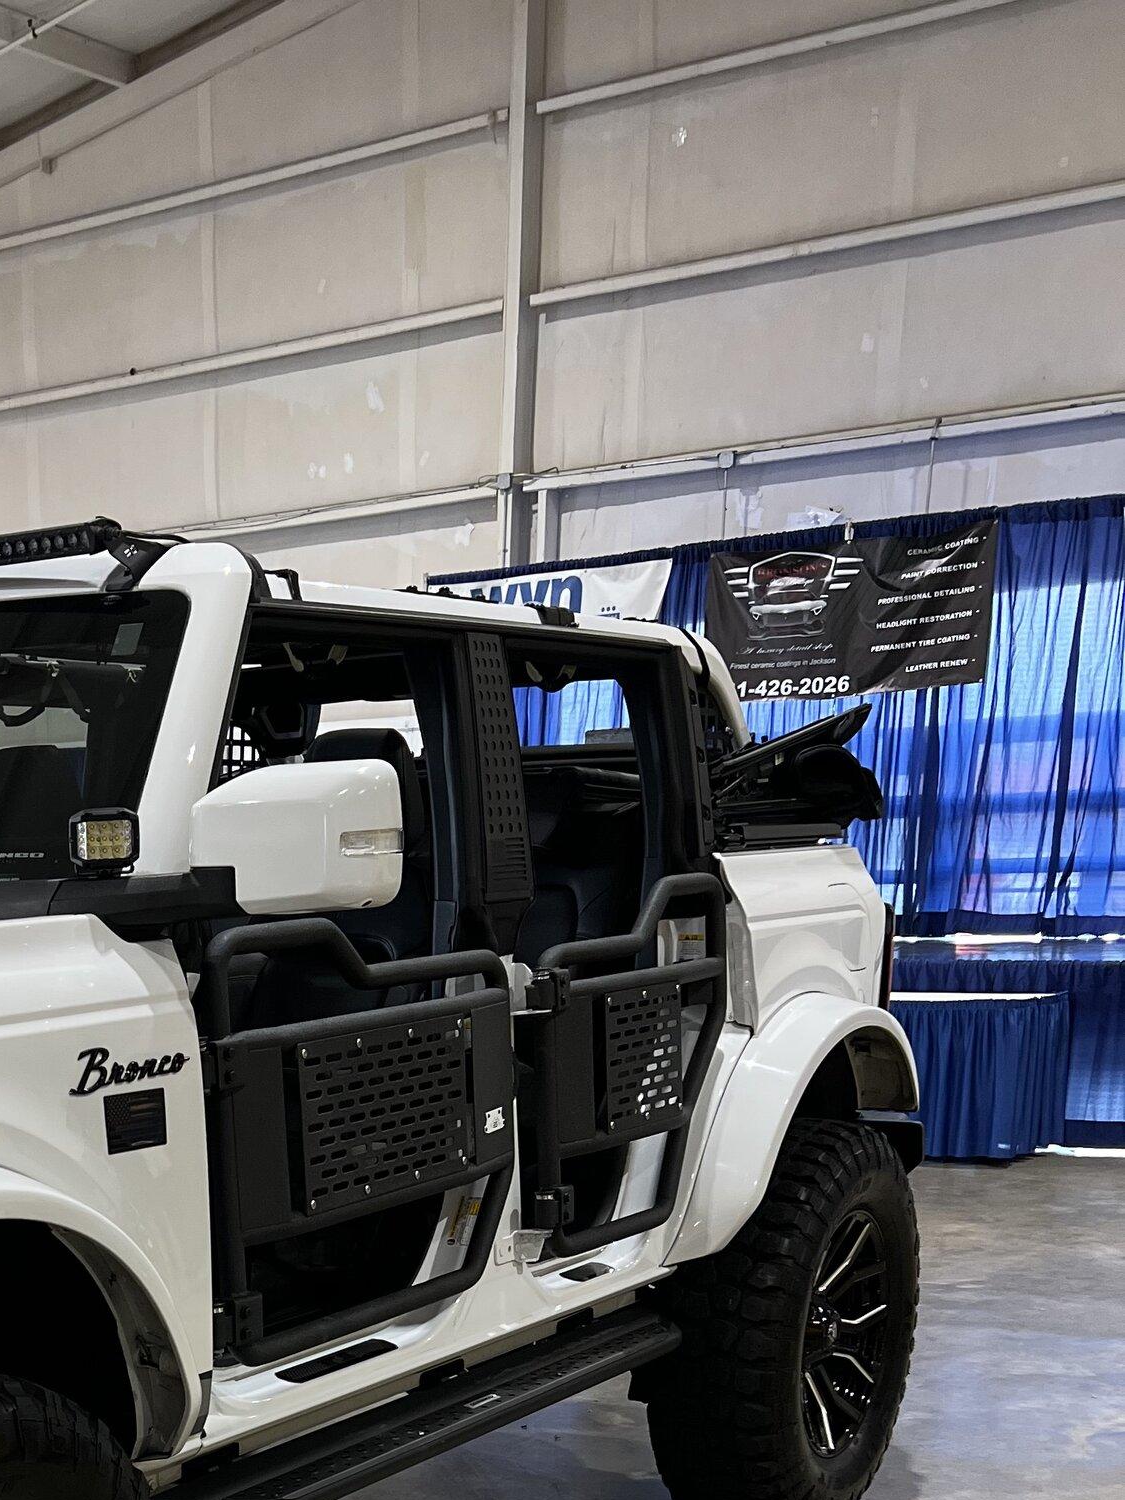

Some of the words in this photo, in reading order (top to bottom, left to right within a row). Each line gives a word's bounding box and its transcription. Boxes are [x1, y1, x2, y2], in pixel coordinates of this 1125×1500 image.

[907, 545, 943, 556] CERAMIC
[944, 537, 979, 550] COATING
[901, 570, 924, 580] PAINT
[925, 562, 978, 576] CORRECTION
[877, 592, 932, 606] PROFESSIONAL
[934, 585, 975, 598] DETAILING
[876, 618, 918, 629] HEADLIGHT
[919, 610, 973, 624] RESTORATION
[871, 641, 916, 653] PERMANENT
[918, 638, 935, 647] TIRE
[937, 634, 970, 644] COATING
[729, 662, 750, 670] Finest
[776, 660, 801, 668] coatings
[809, 658, 836, 666] Jackson
[905, 662, 938, 673] LEATHER
[940, 658, 968, 668] RENEW
[68, 1047, 191, 1096] Bronco
